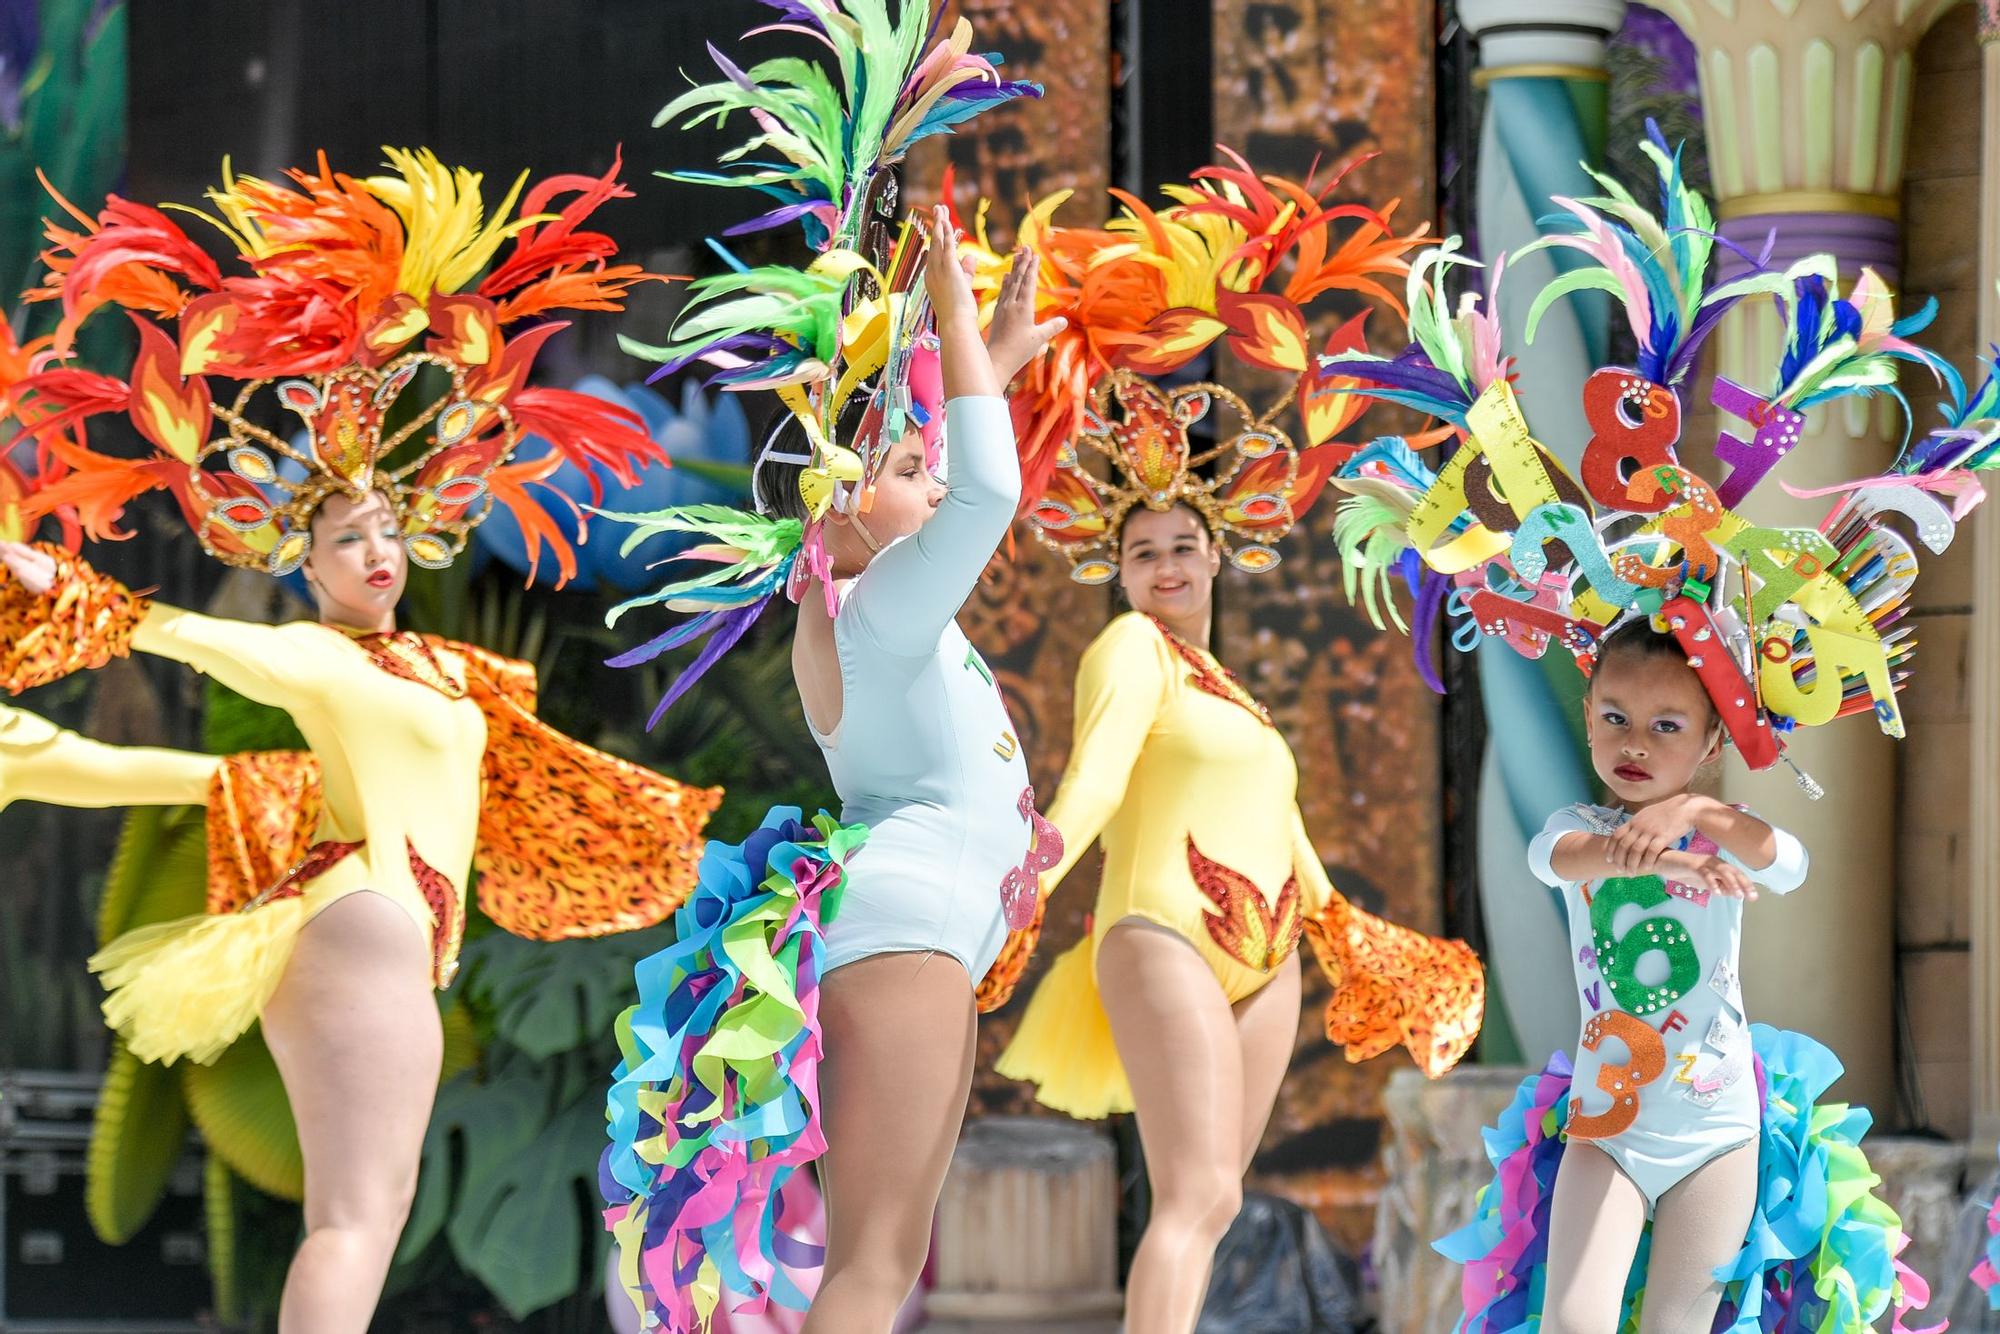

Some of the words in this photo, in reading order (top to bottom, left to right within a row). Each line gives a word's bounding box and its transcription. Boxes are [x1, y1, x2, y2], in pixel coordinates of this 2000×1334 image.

[1581, 367, 1682, 513] 8
[1653, 465, 1684, 495] R
[1510, 502, 1644, 613] 2
[1597, 463, 1723, 590] 3
[1583, 981, 1601, 1011] V
[1590, 873, 1700, 1017] 6
[1563, 1009, 1667, 1139] 3
[1659, 1009, 1689, 1035] F
[1674, 1052, 1697, 1085] Z
